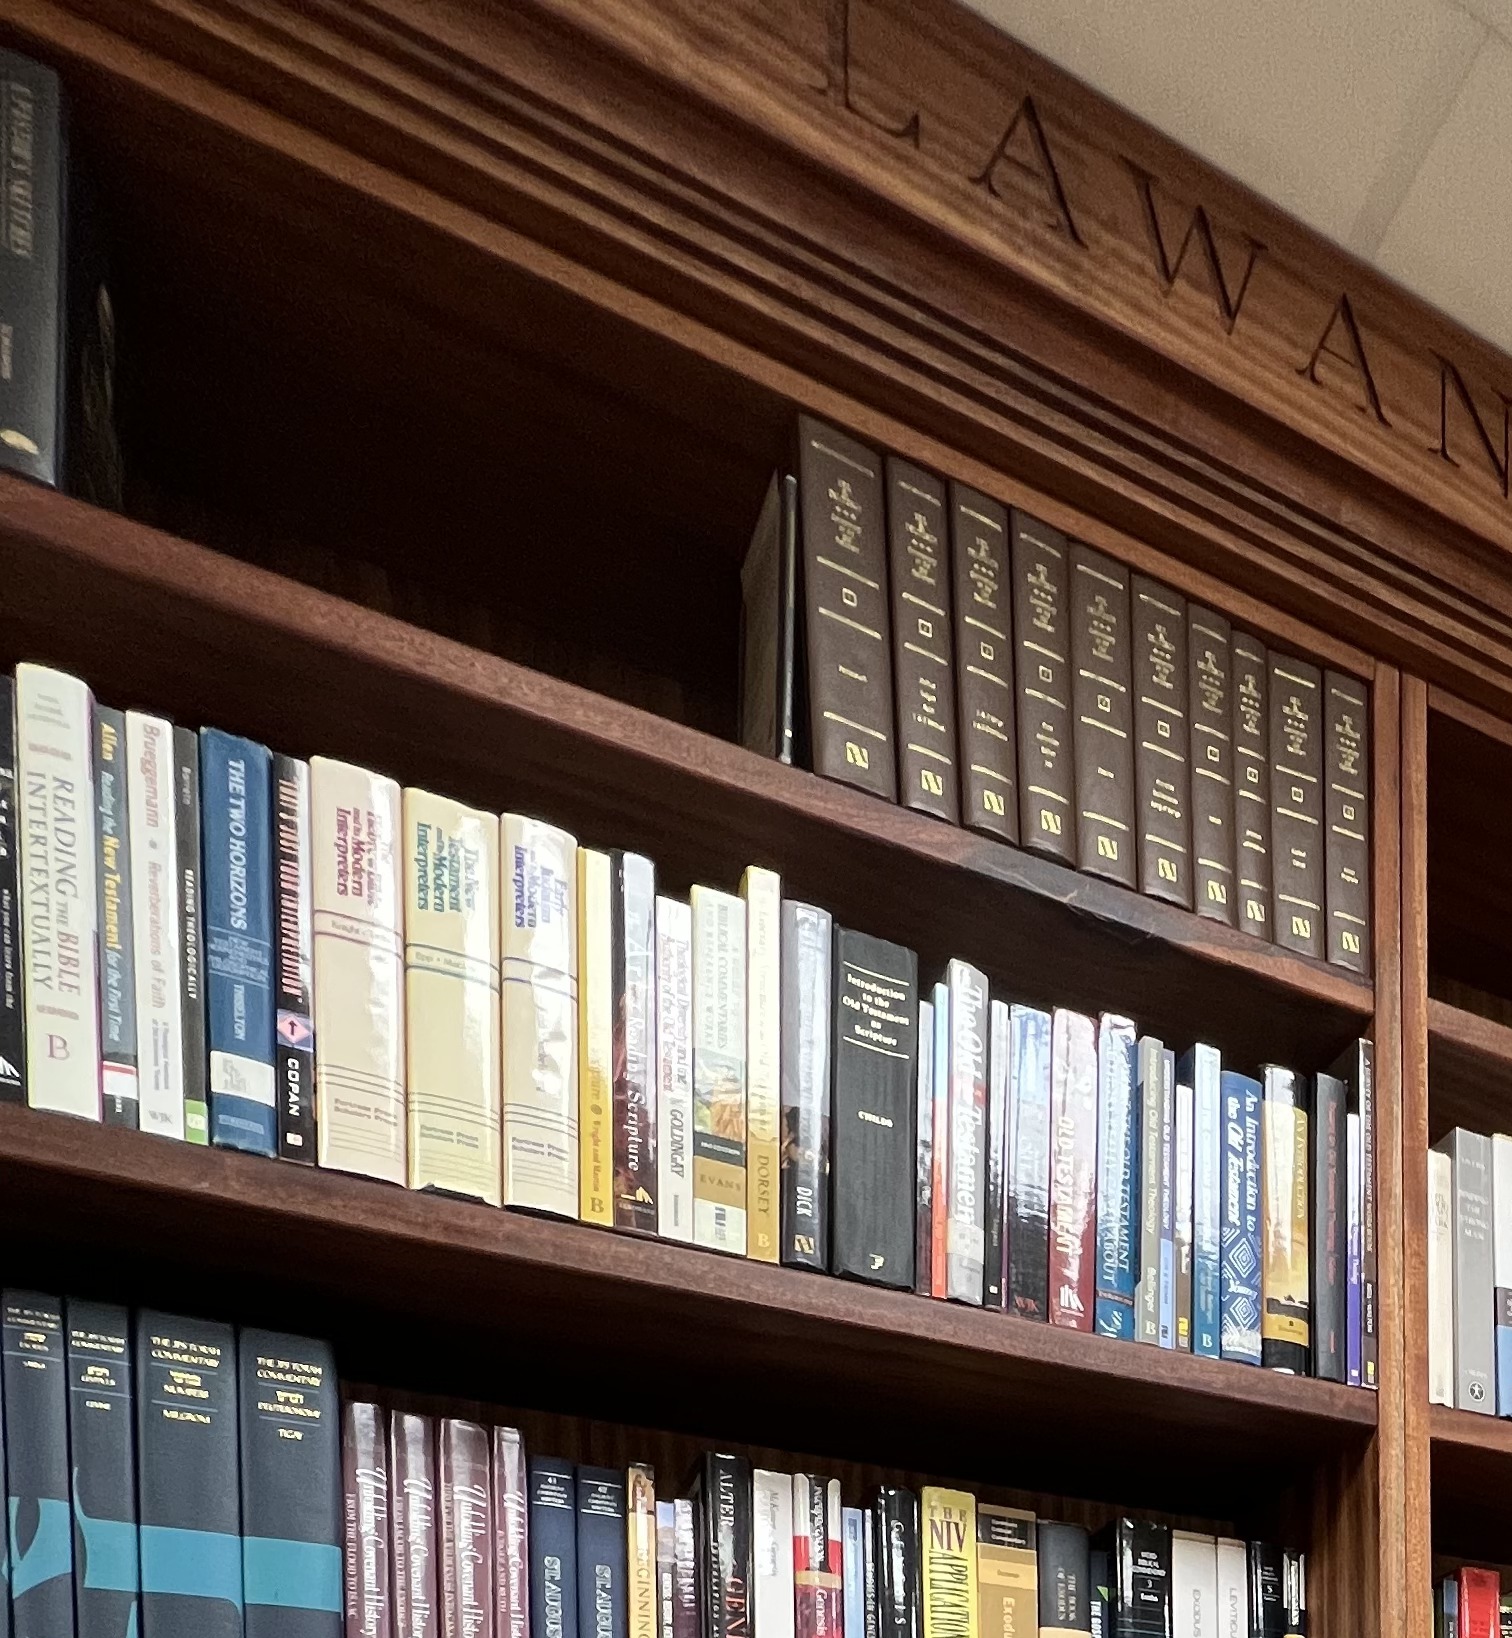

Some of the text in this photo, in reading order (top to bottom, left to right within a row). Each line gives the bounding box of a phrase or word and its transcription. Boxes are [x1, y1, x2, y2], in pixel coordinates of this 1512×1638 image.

[100, 722, 115, 761] Allen
[141, 723, 160, 829] Brueggemann
[228, 759, 249, 931] THE TWO HORIZONS
[335, 807, 350, 896] Interpreters
[417, 820, 433, 912] Interpreters
[26, 771, 54, 991] INTERTEXTUALLY
[847, 973, 906, 1000] Introduction
[854, 1024, 897, 1047] Scripture
[286, 1057, 302, 1117] COPAN
[627, 1076, 641, 1172] Scripture
[671, 1108, 684, 1177] GOLDINGAY
[757, 1154, 770, 1215] DORSEY
[796, 1186, 812, 1218] DICK
[720, 1470, 734, 1527] ALTER
[930, 1505, 966, 1520] THE
[930, 1520, 966, 1551] NIV
[817, 1589, 828, 1636] Genesis
